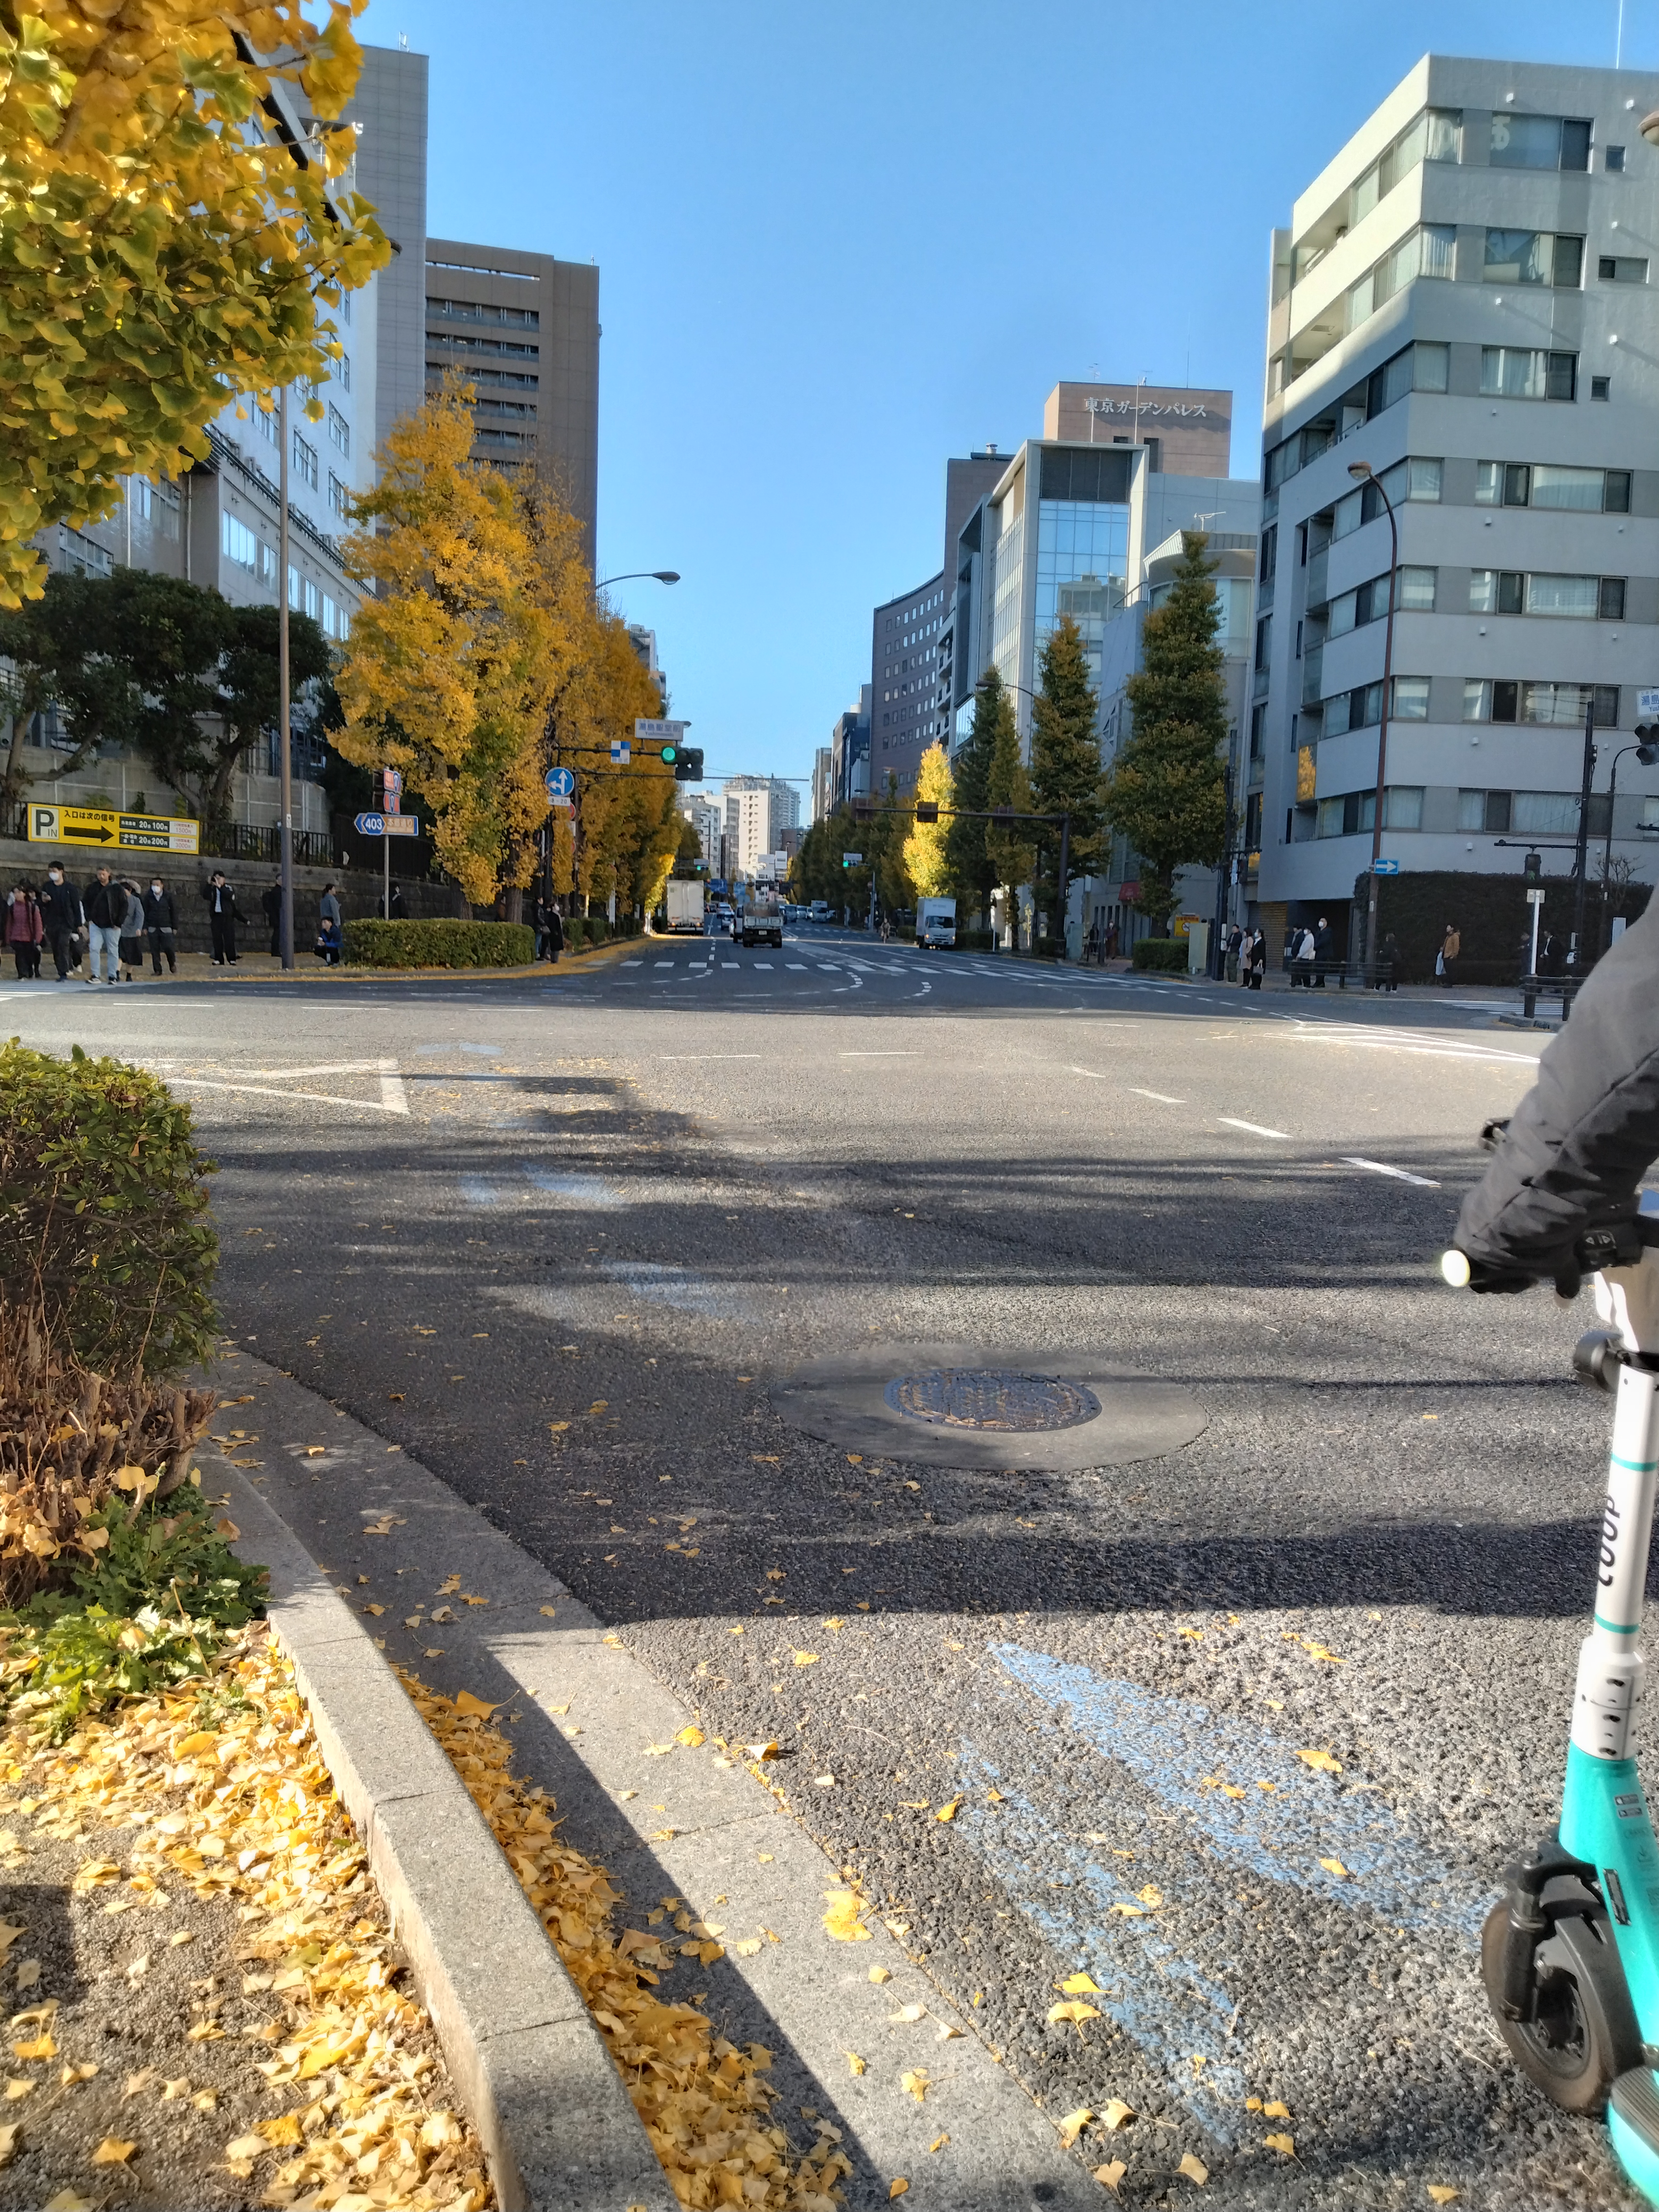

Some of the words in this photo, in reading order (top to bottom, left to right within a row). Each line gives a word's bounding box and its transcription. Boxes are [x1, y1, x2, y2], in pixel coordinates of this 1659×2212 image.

[1084, 397, 1206, 417] 東京ガーデンパレス
[36, 809, 54, 836] P
[64, 809, 115, 823] 入口は次の信号
[365, 818, 382, 830] 403
[48, 828, 57, 837] IN
